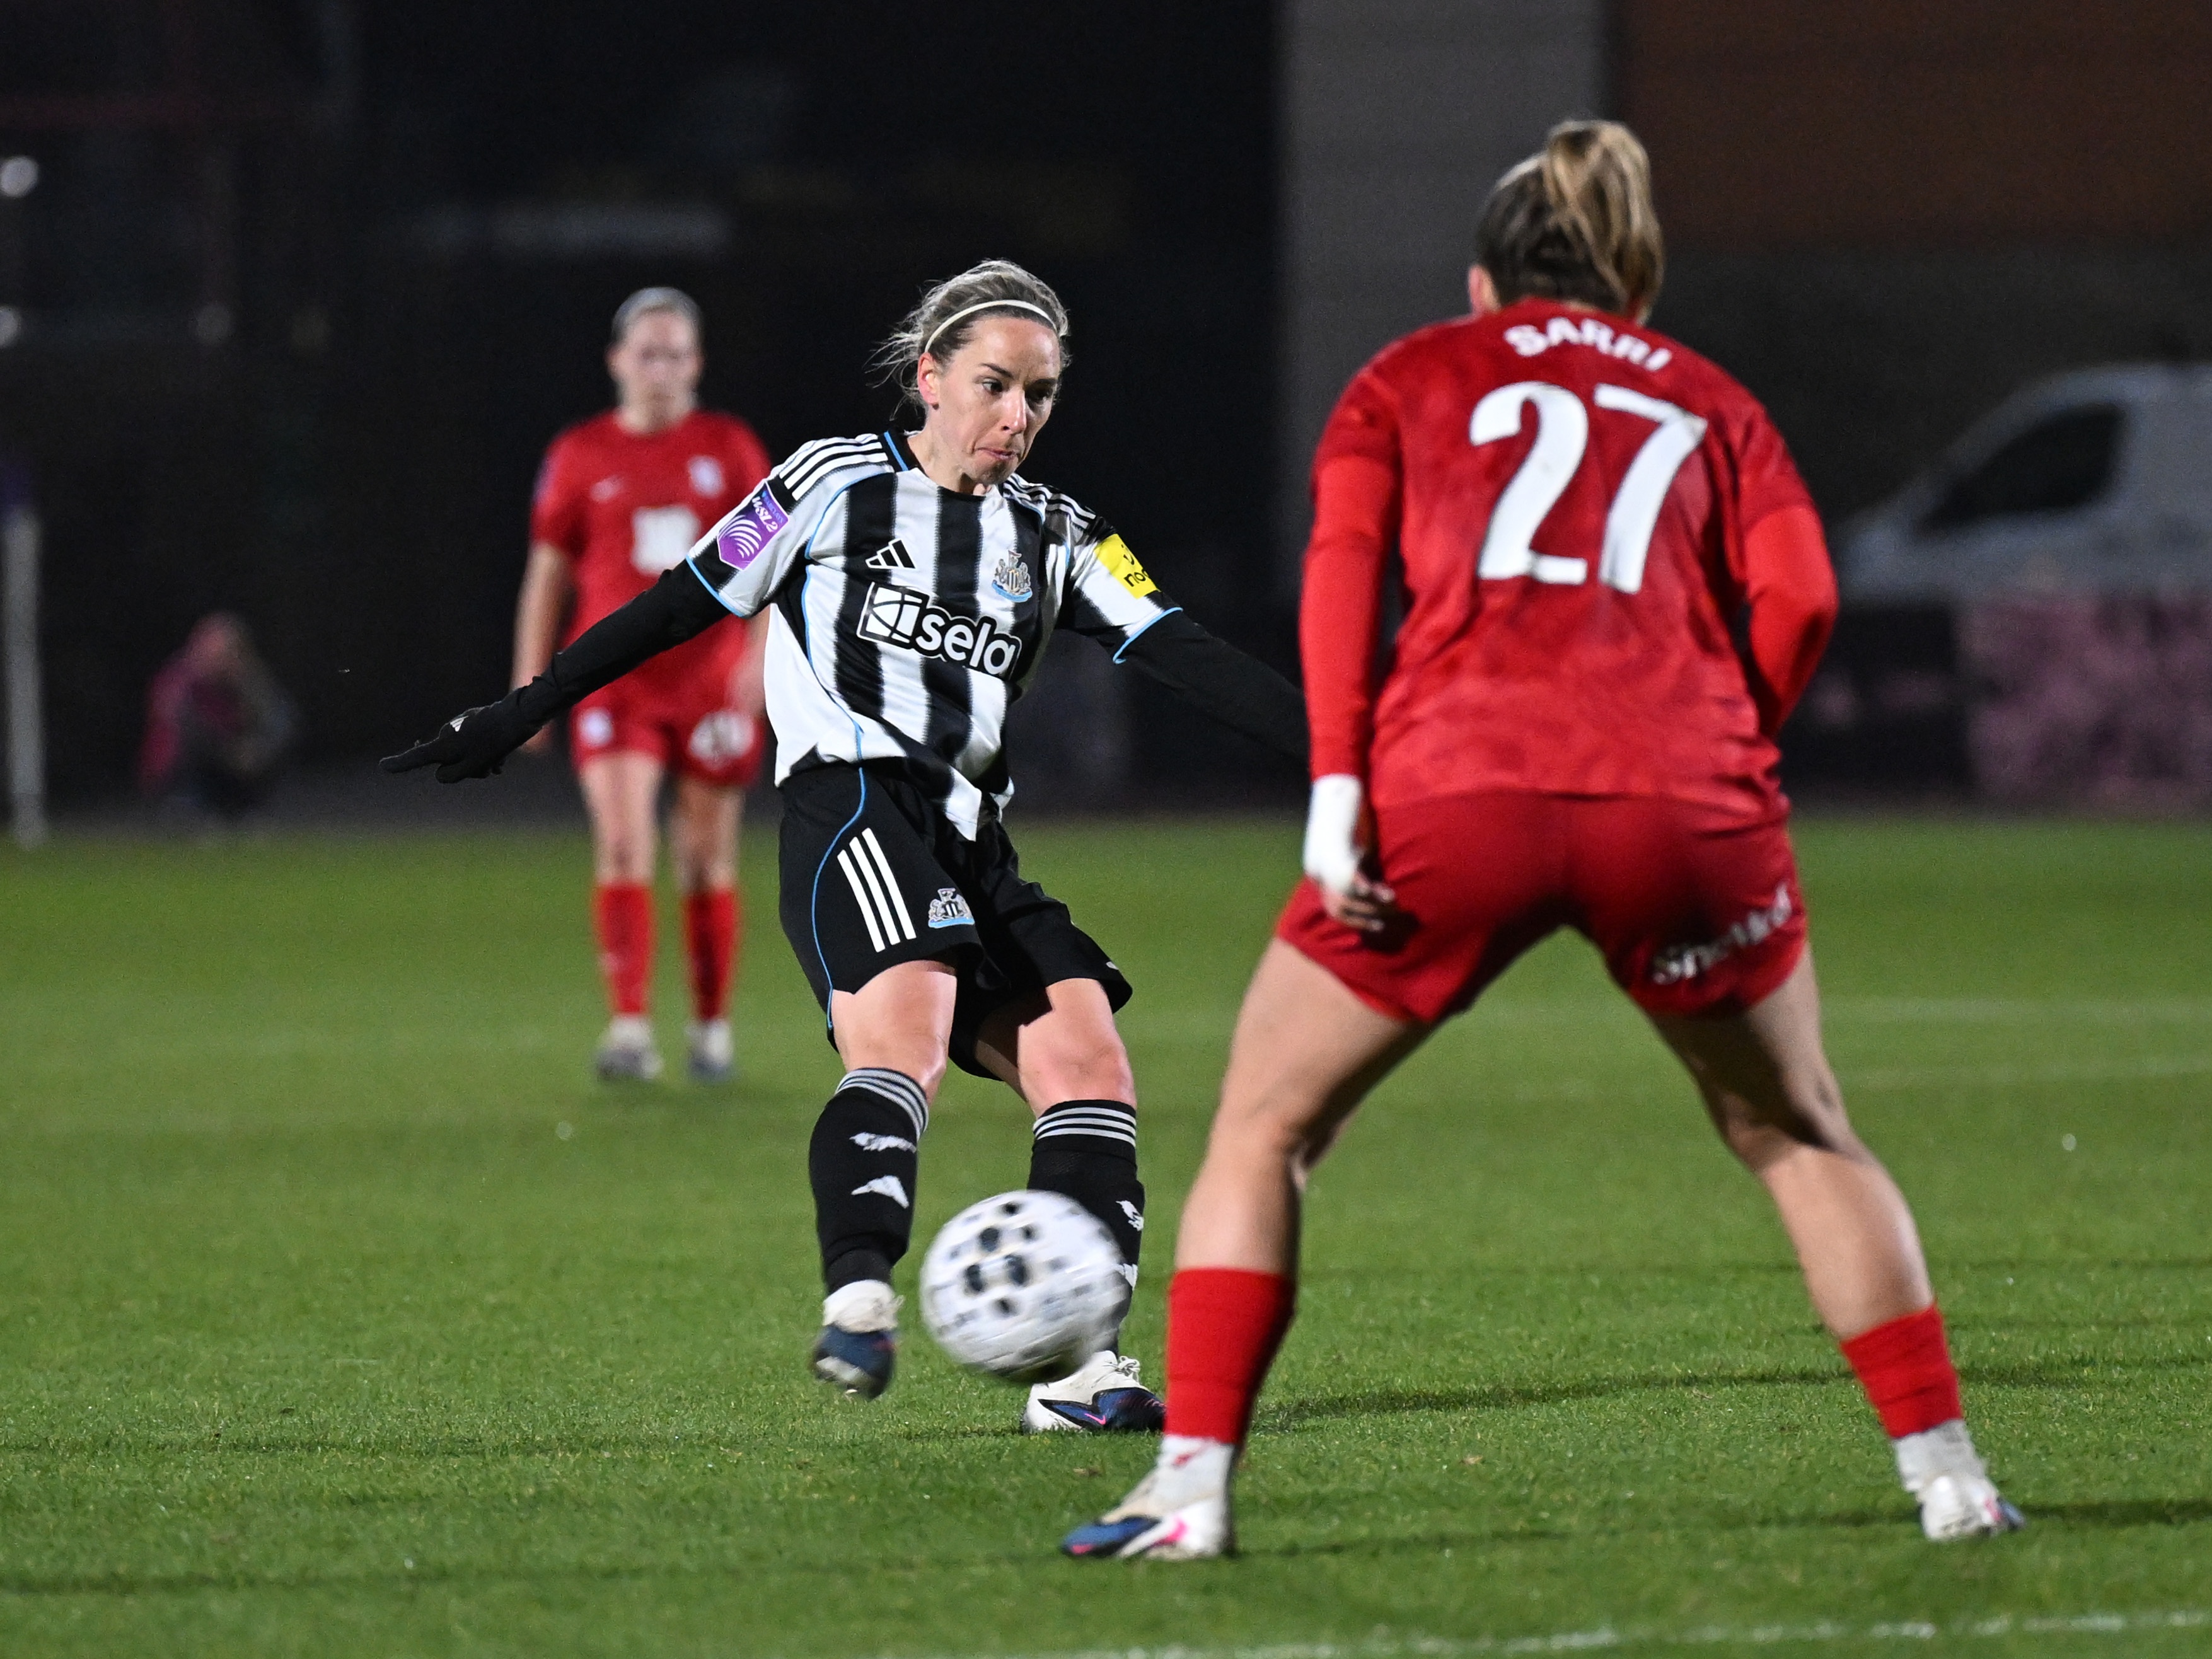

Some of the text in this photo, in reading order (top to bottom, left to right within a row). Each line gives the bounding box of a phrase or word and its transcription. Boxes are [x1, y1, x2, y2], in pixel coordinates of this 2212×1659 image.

[1504, 316, 1672, 371] SARRI
[1469, 381, 1707, 594] 27
[915, 614, 1016, 674] sela
